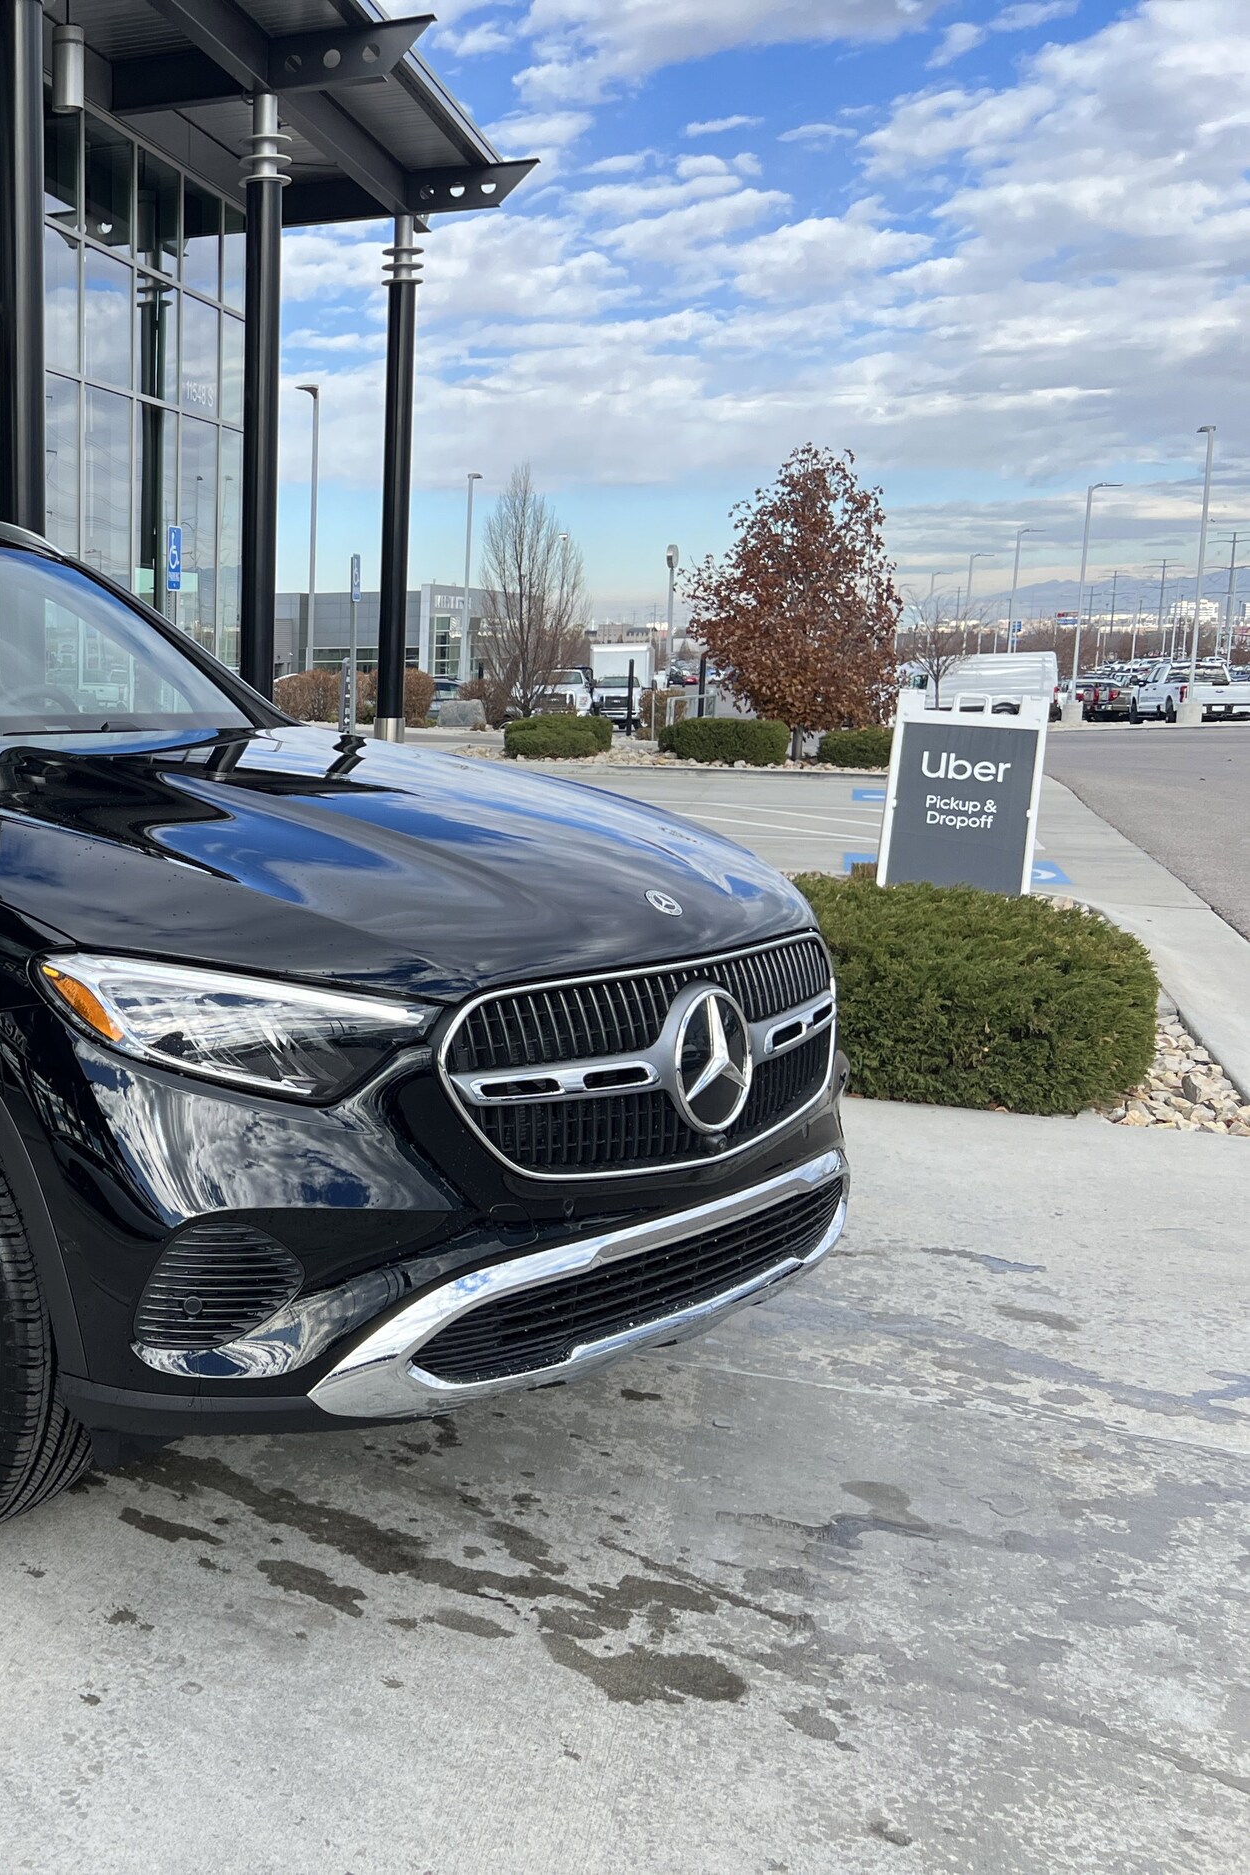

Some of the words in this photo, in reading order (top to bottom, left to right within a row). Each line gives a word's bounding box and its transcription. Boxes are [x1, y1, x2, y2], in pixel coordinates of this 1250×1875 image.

[921, 750, 1012, 783] Uber
[925, 794, 981, 814] Pickup
[983, 799, 997, 813] &
[926, 811, 994, 829] Dropoff
